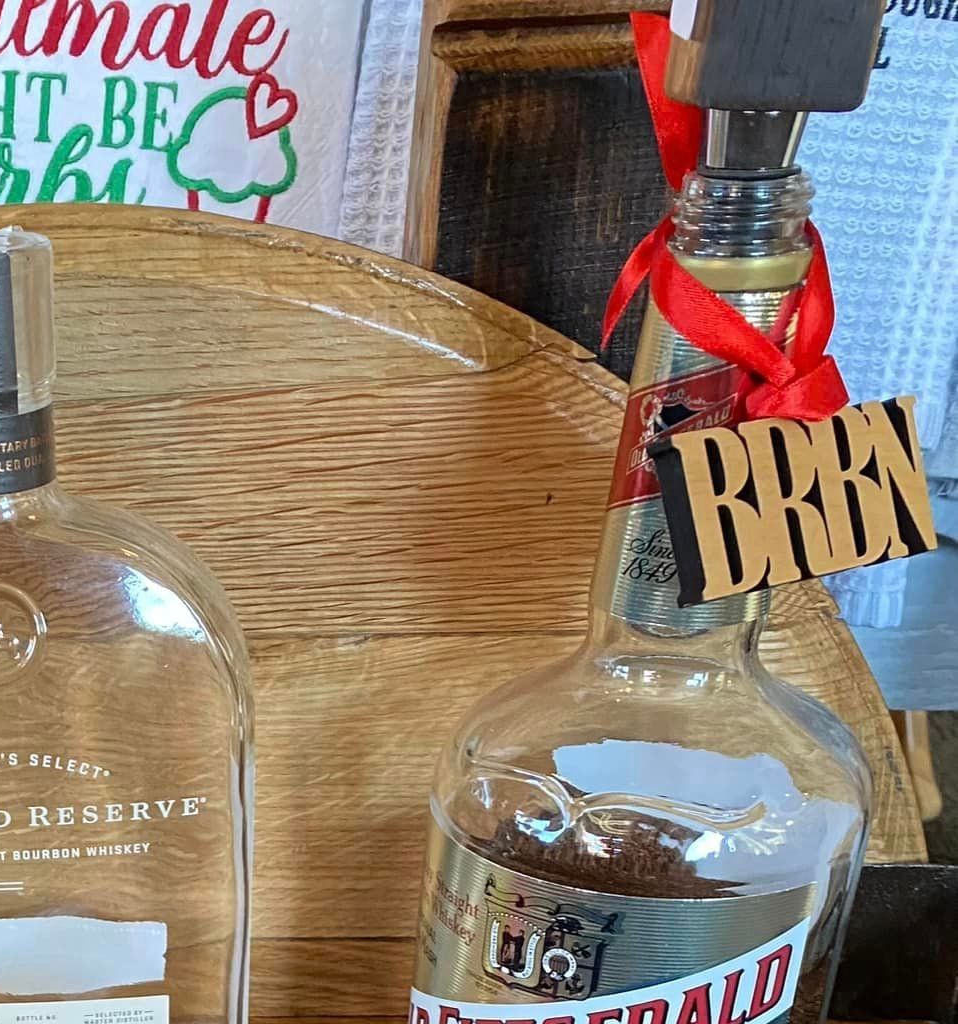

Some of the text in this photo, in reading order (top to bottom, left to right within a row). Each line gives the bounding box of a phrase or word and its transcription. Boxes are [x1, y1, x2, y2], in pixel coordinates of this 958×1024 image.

[97, 76, 179, 152] BE
[668, 395, 938, 602] BRBN
[622, 556, 678, 584] 1849
[13, 847, 81, 861] BOURBON
[86, 842, 151, 857] WHISKEY
[95, 1010, 132, 1018] SELECTED
[116, 1016, 154, 1024] DISTILLER
